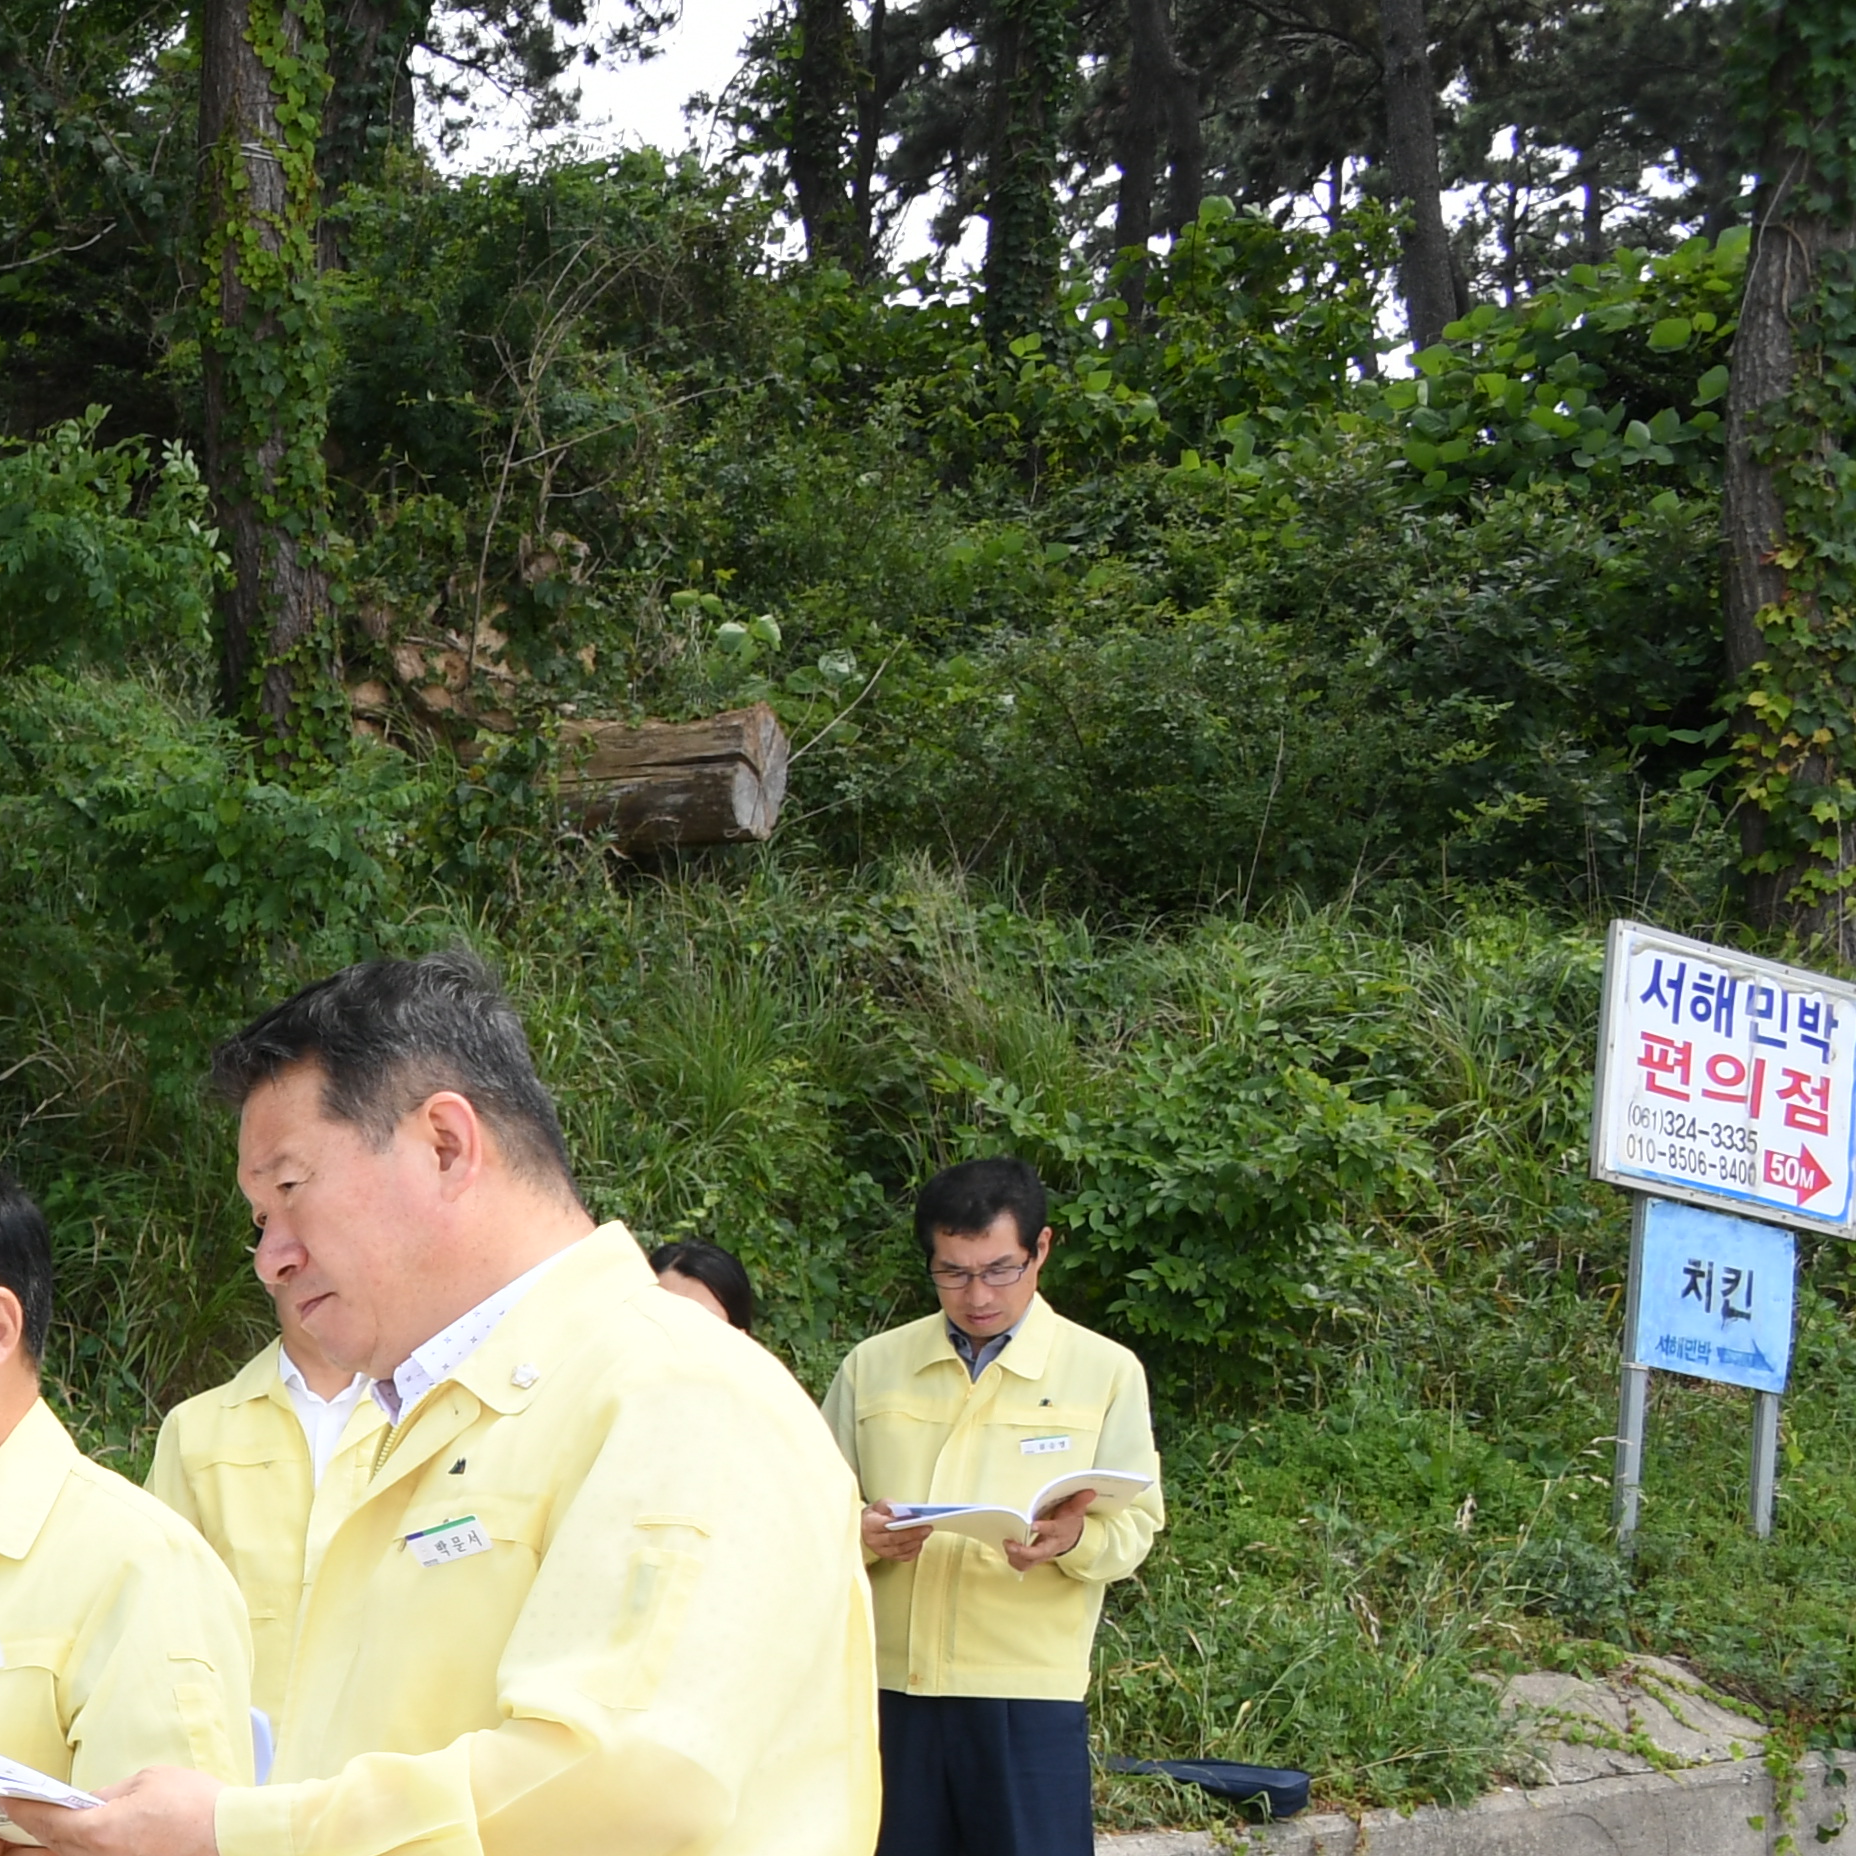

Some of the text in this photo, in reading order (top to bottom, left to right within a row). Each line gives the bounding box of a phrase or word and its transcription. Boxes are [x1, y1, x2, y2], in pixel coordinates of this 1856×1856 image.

[1639, 957, 1839, 1065] 서해민박
[1636, 1030, 1832, 1137] 편의점
[1627, 1100, 1758, 1156] (061)324-3335
[1770, 1153, 1816, 1190] 50M
[1681, 1257, 1755, 1321] 치킨
